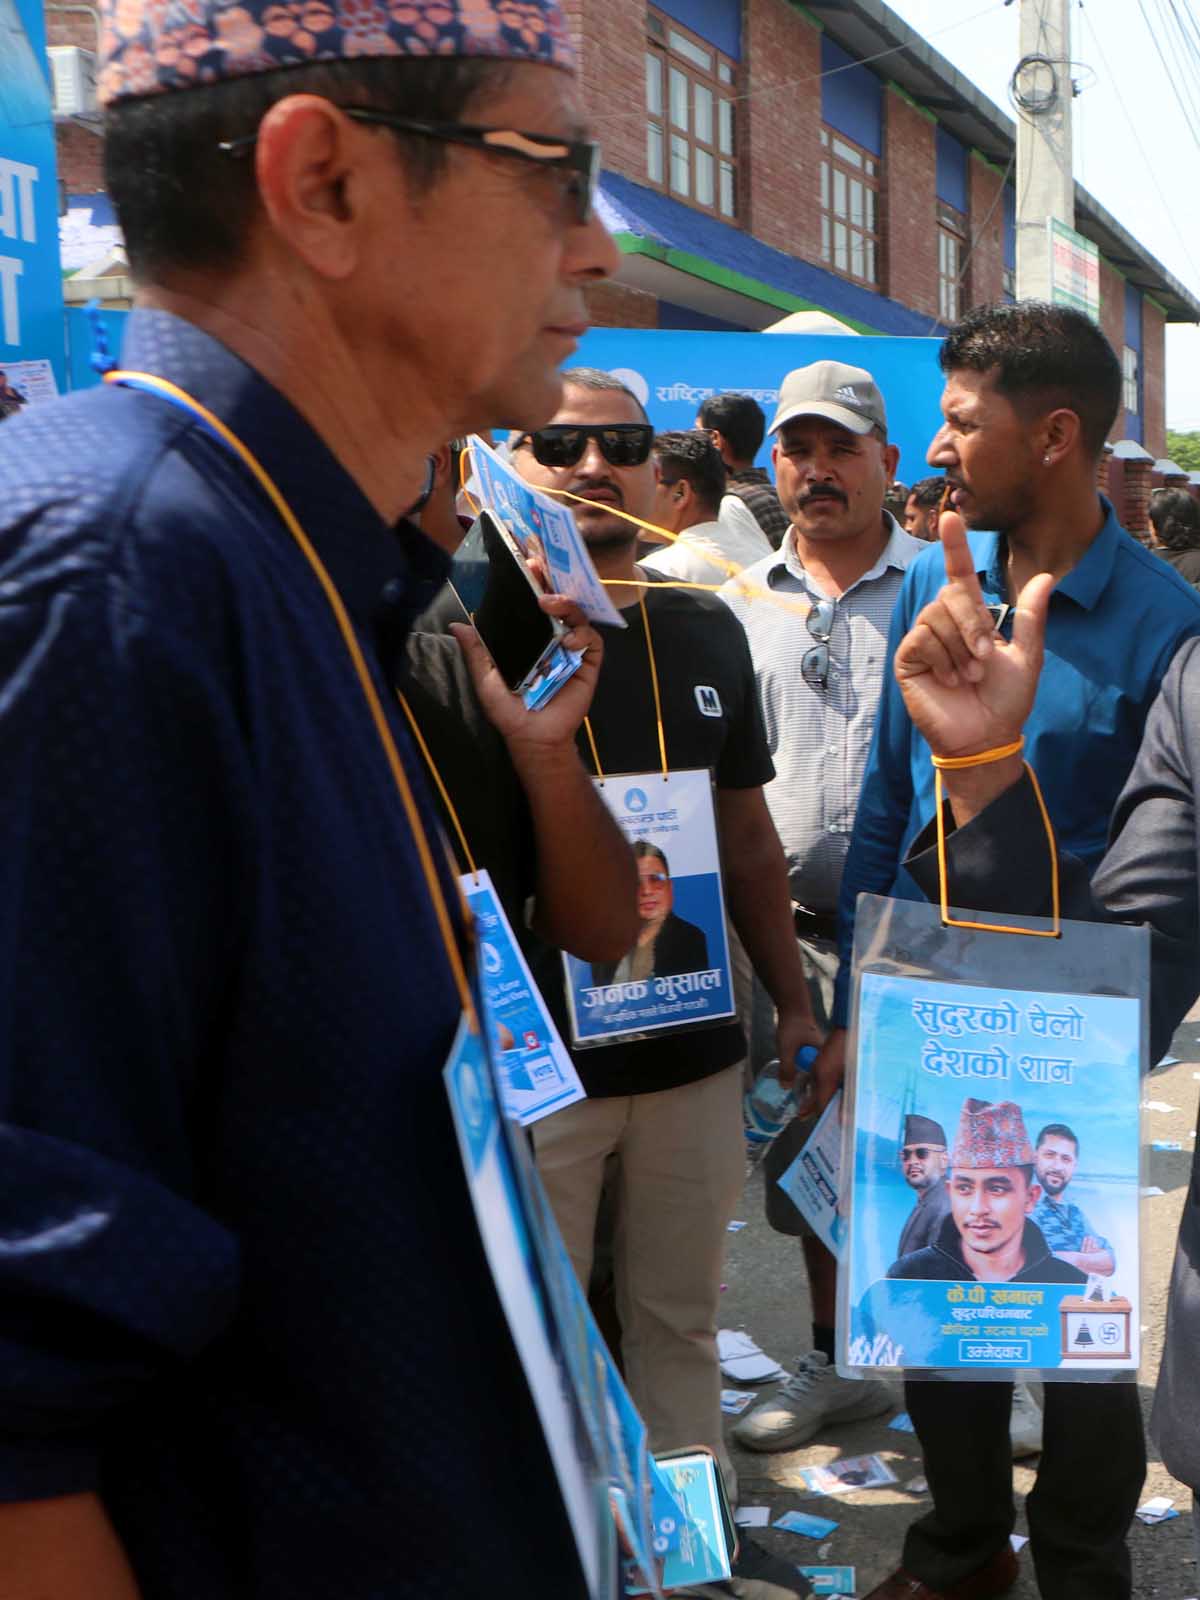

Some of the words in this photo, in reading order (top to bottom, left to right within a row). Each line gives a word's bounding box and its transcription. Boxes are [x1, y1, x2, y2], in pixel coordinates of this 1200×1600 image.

[580, 979, 649, 1008] जनक
[652, 967, 721, 1002] भुसाल
[913, 999, 1020, 1039] सुदुरको
[1027, 1002, 1086, 1042] चेलो
[922, 1039, 1011, 1081] देशको
[1018, 1055, 1074, 1086] शान
